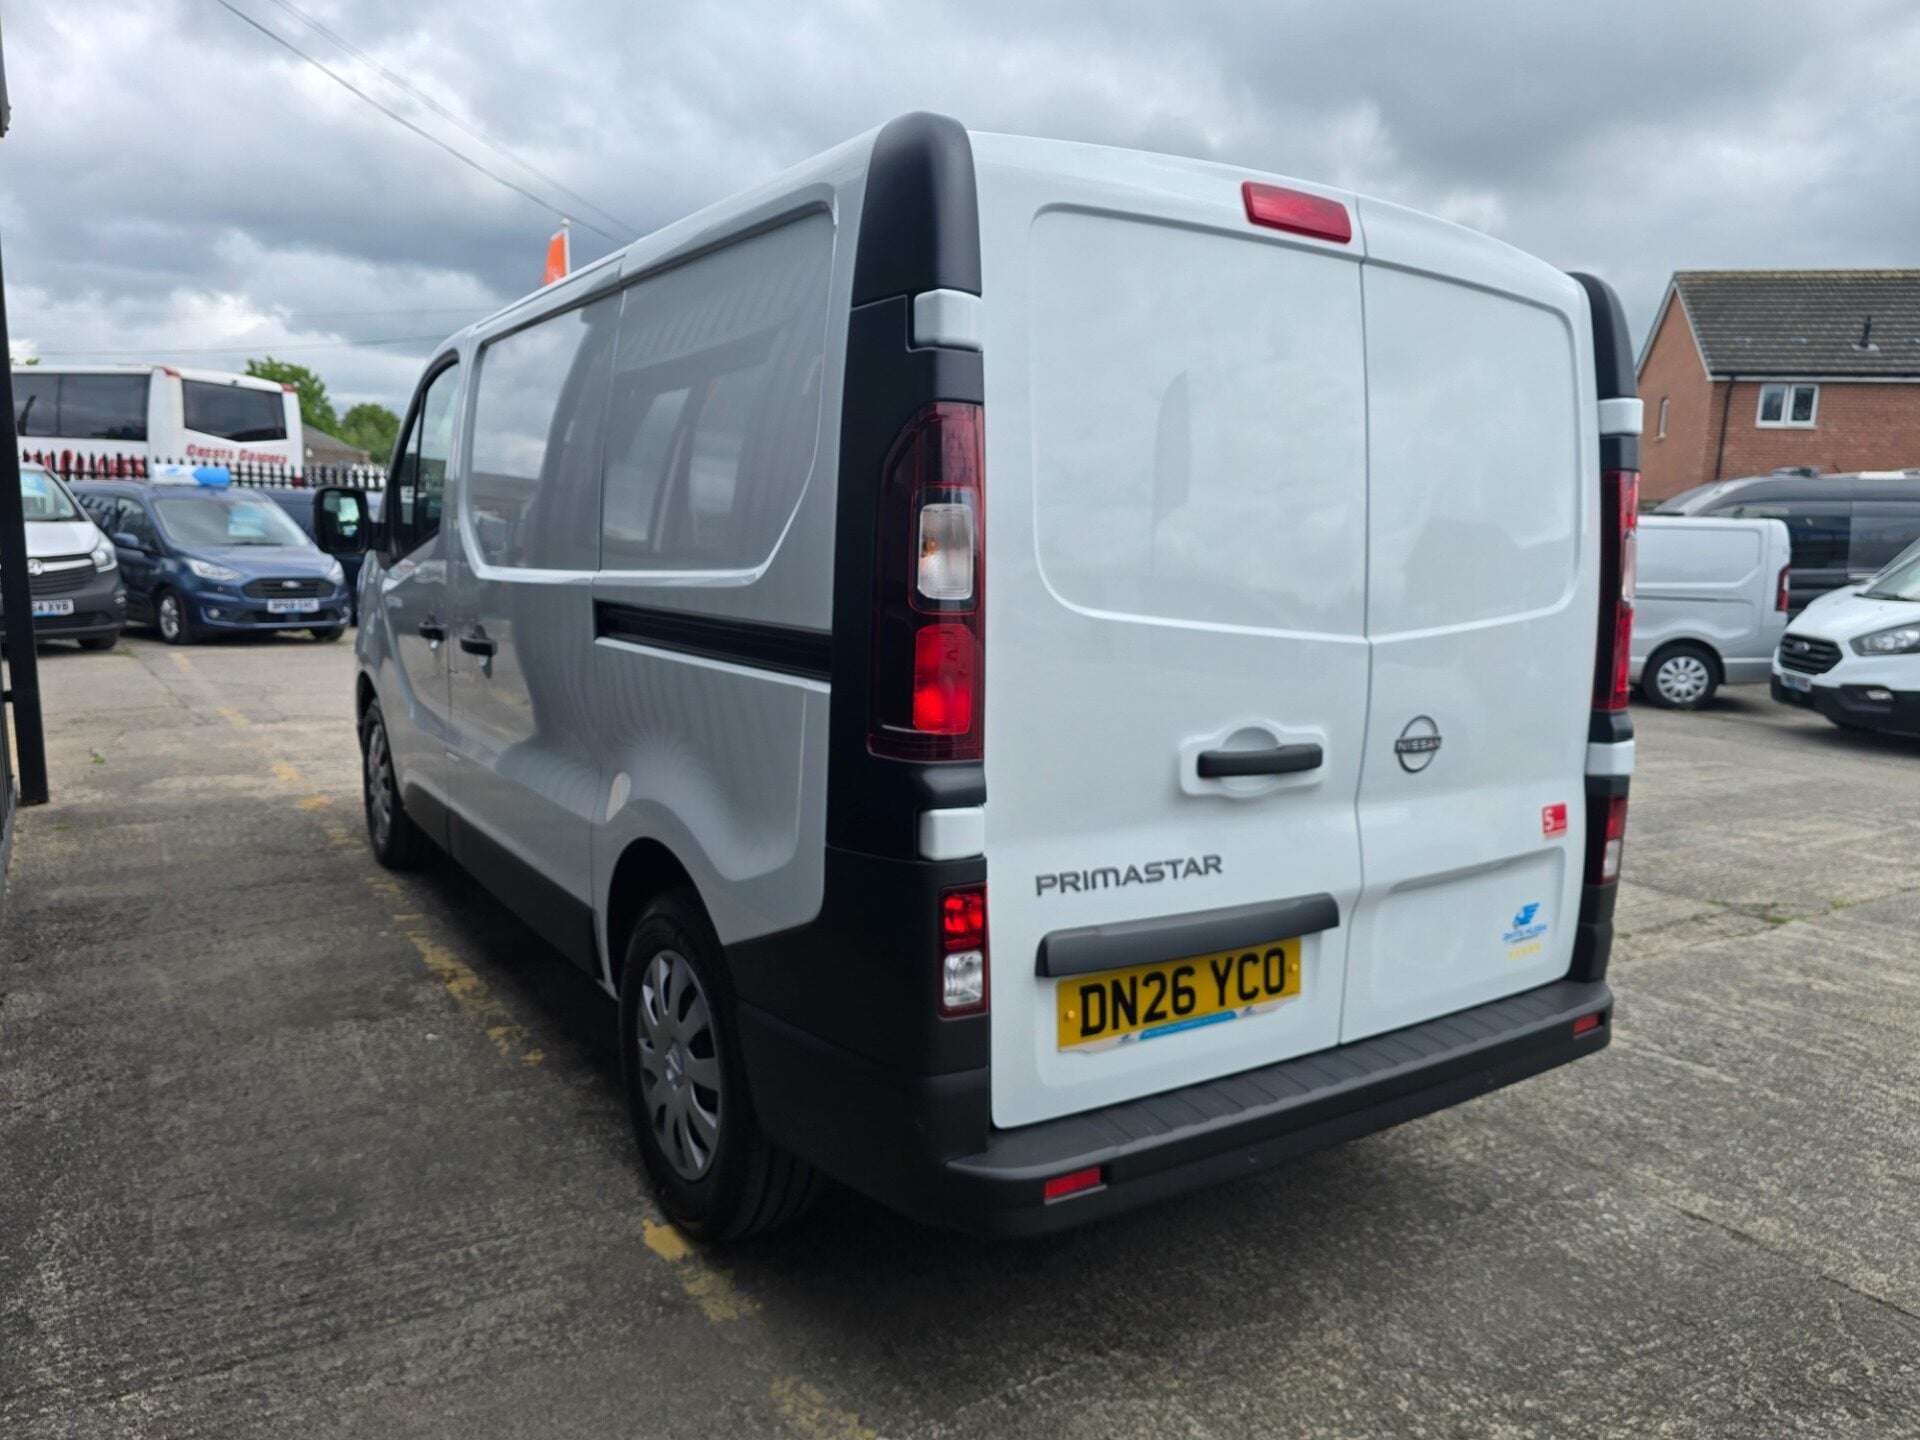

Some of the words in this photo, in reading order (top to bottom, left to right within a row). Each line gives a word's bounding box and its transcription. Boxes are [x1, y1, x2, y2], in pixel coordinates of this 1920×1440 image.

[1397, 737, 1441, 752] NISSAN
[1035, 854, 1223, 896] PRIMASTAR
[1079, 966, 1196, 1038] DN26
[1211, 947, 1286, 1008] YCO
